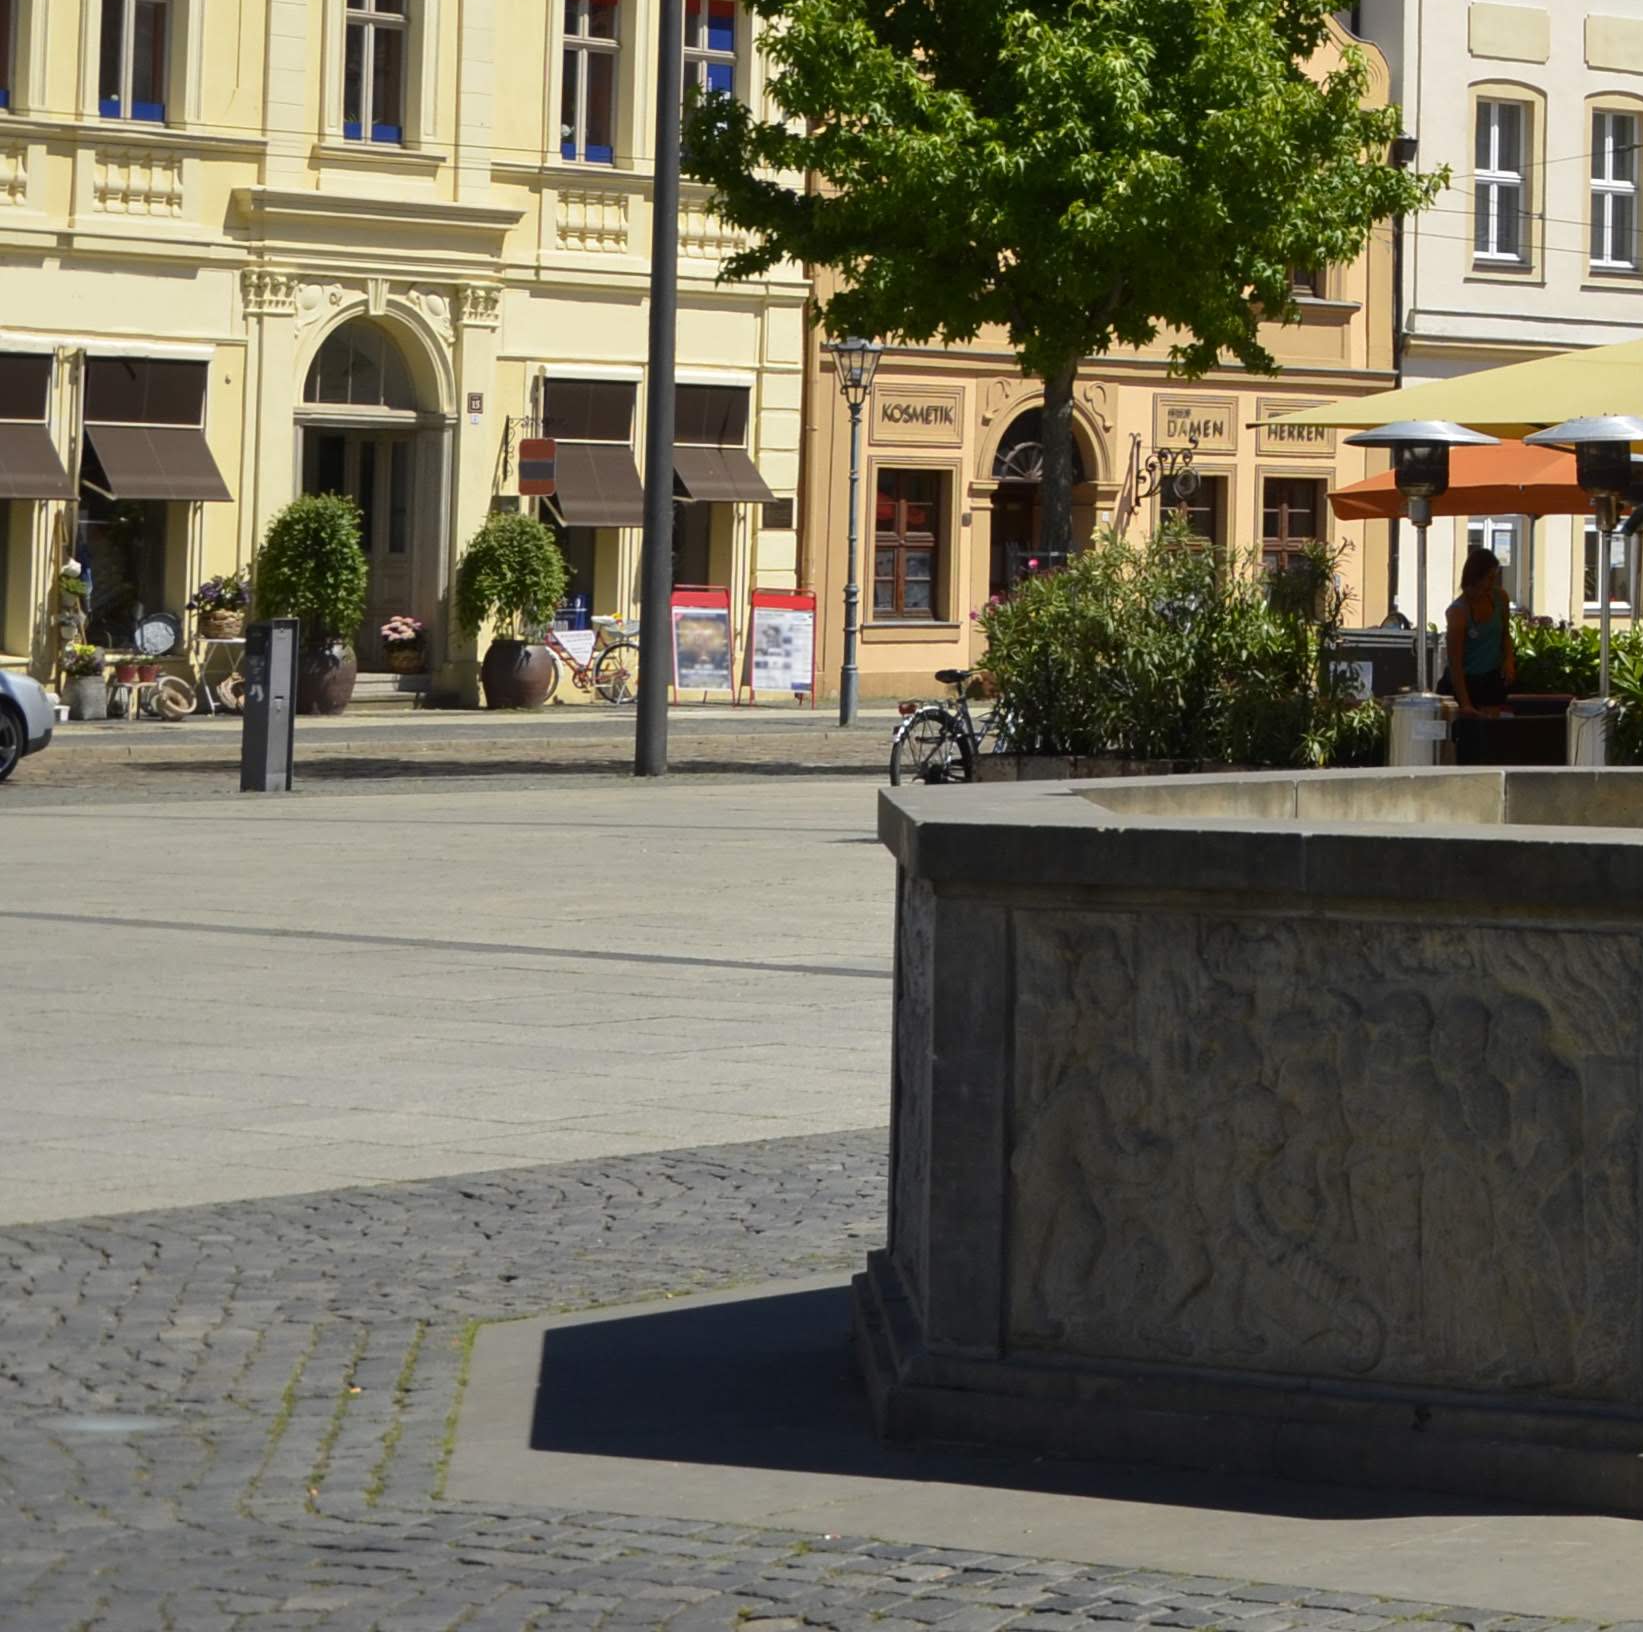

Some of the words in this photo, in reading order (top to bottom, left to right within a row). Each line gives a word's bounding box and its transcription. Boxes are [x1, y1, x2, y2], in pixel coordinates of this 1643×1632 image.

[881, 403, 954, 425] KOSMETIK
[1167, 419, 1224, 439] DAMEN
[1267, 424, 1325, 442] HERREN
